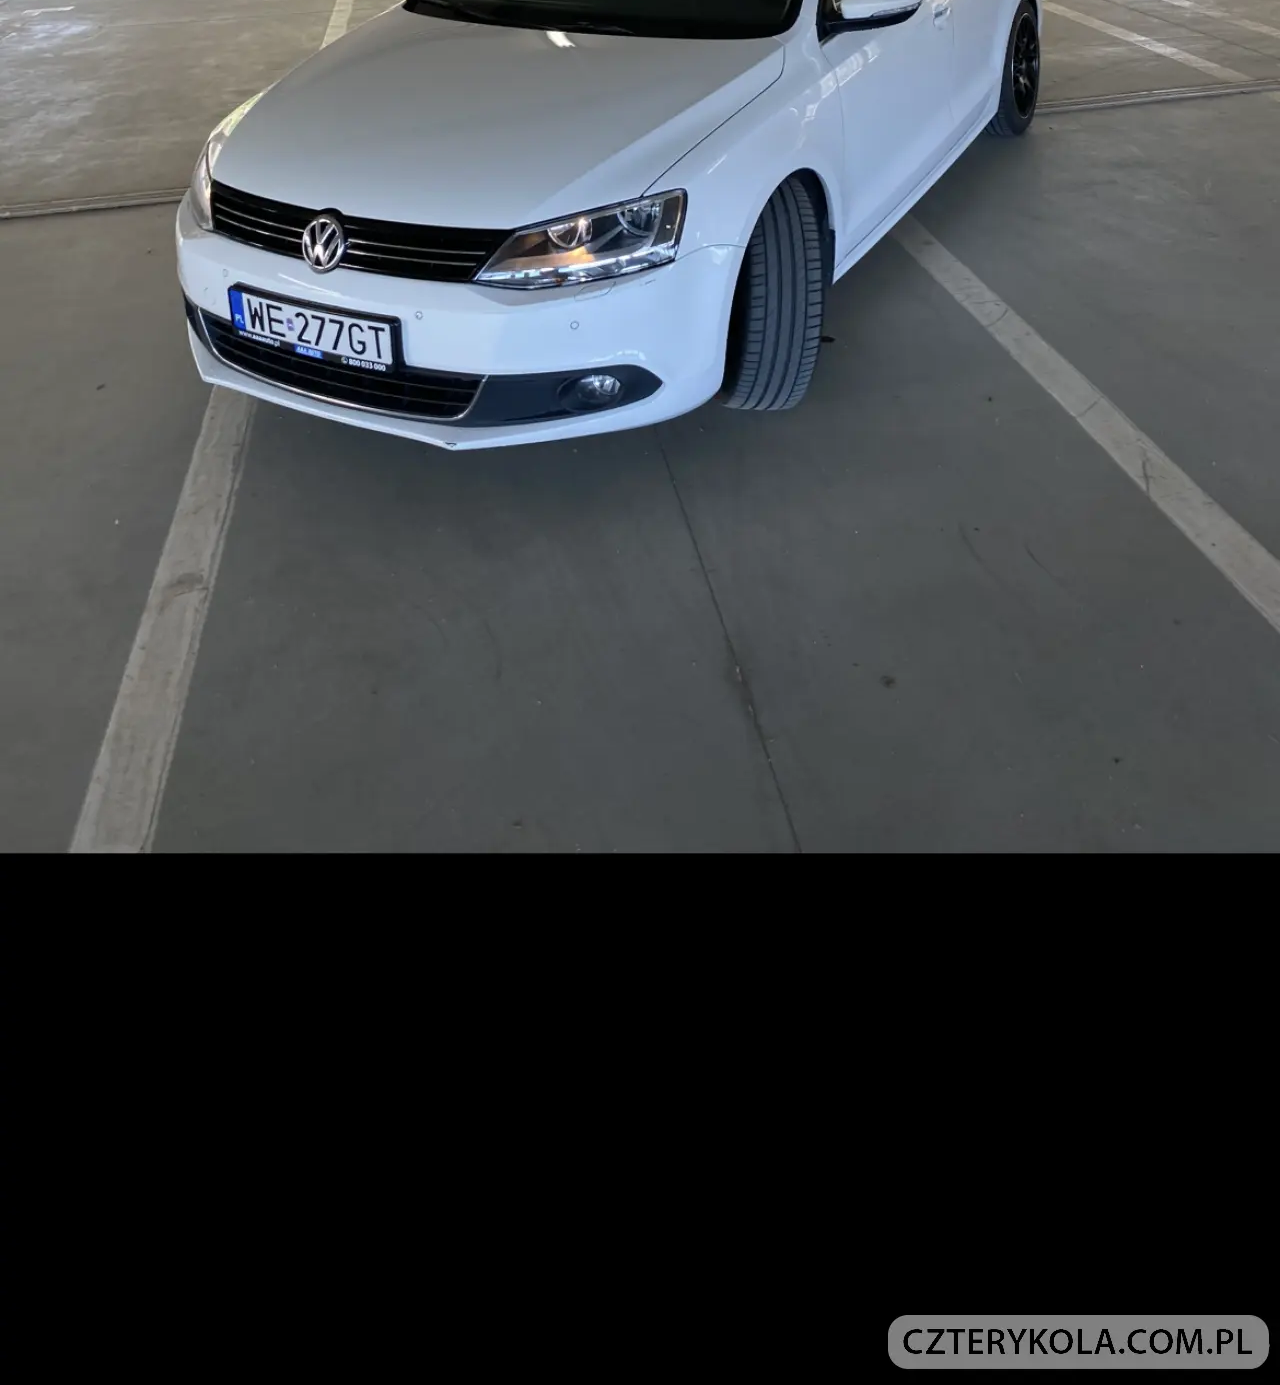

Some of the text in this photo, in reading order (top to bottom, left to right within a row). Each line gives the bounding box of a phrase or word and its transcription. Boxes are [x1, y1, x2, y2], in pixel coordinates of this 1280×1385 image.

[234, 313, 244, 324] PL
[247, 298, 385, 359] WE 277GT
